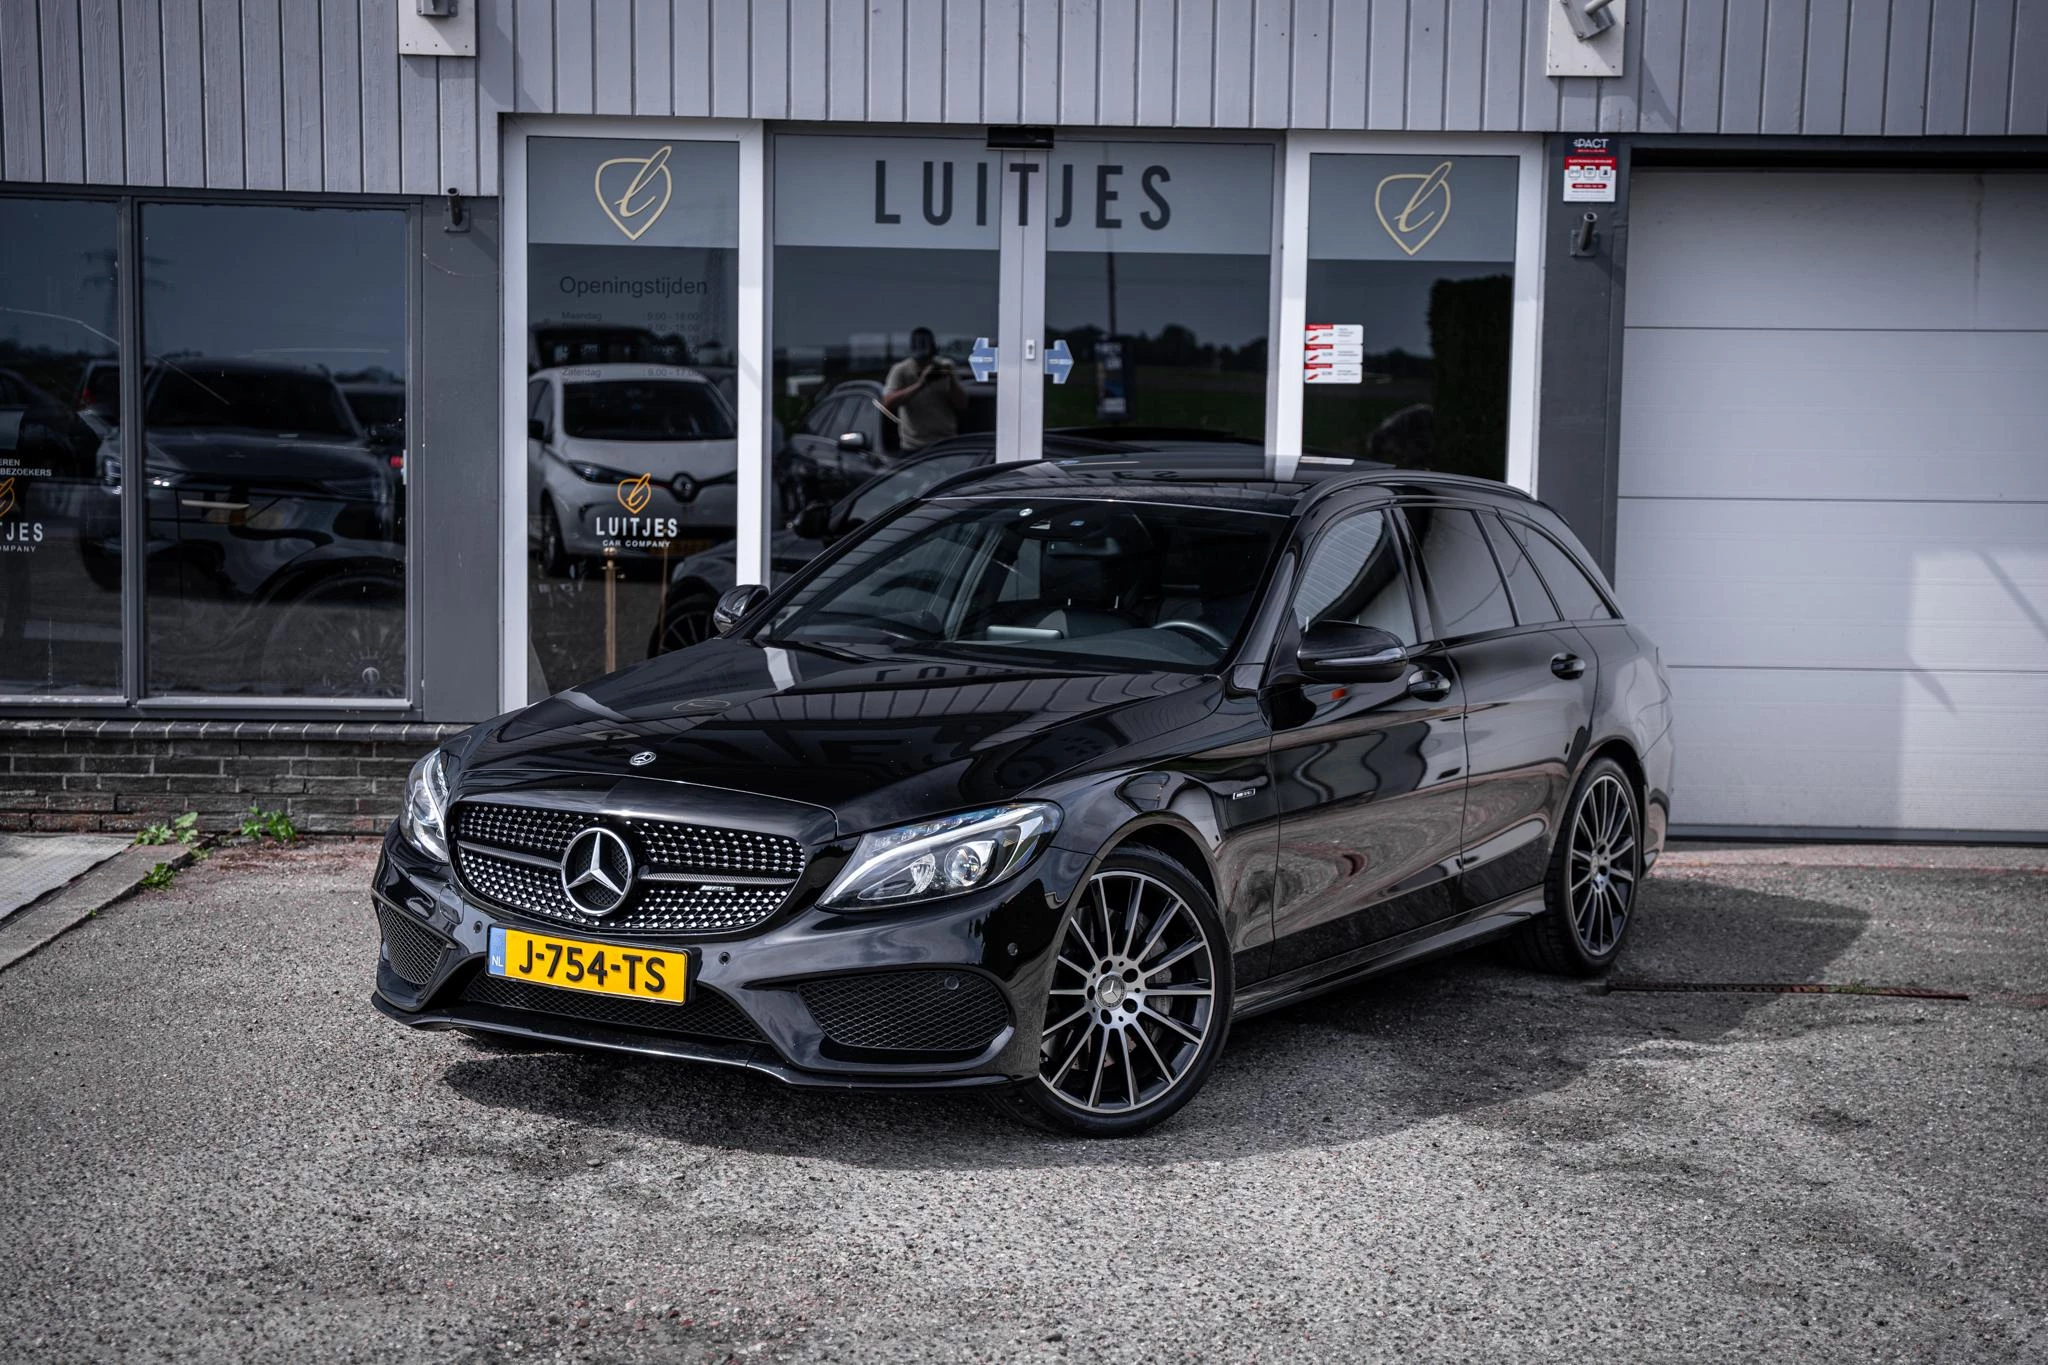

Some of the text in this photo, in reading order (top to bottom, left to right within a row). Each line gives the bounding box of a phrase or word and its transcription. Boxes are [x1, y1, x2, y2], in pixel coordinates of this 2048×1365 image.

[874, 160, 1171, 231] LUITJES
[559, 275, 708, 298] Openingstijden
[0, 468, 52, 476] BEZOEKERS
[596, 517, 678, 537] LUITJES
[492, 940, 666, 993] NL J-754-TS
